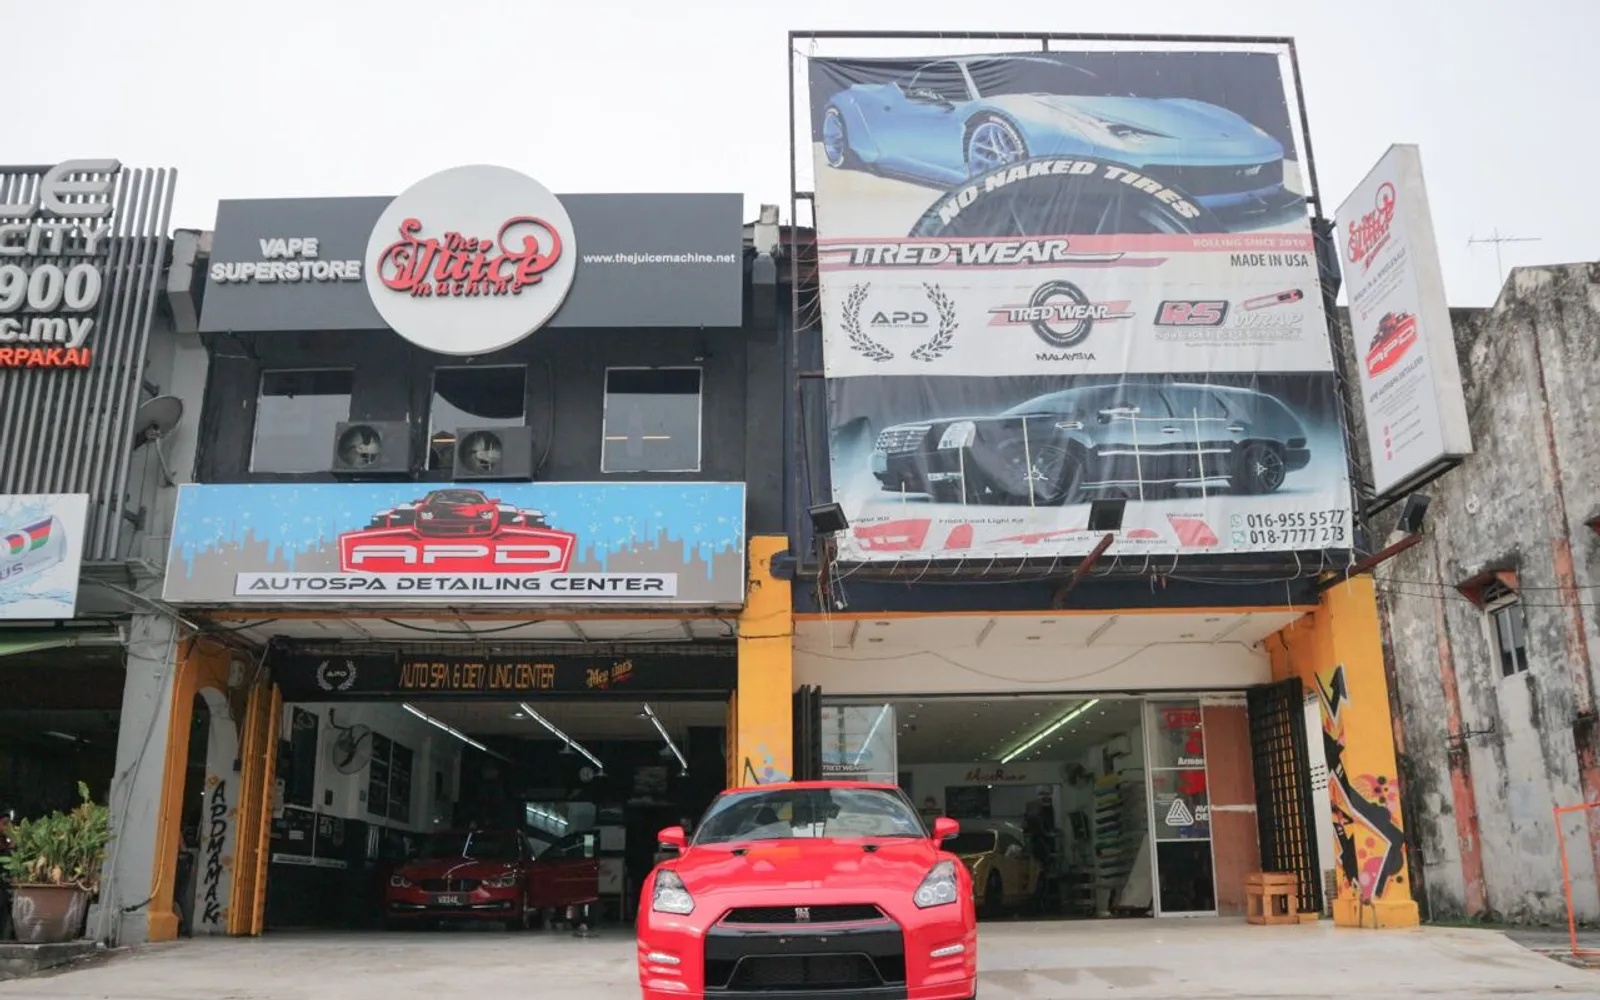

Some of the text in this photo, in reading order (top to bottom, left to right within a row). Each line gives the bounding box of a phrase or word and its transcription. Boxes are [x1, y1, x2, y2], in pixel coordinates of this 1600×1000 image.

[939, 160, 1201, 226] NO NAKED TIRES
[0, 222, 110, 256] CITY
[259, 237, 319, 259] VAPE
[444, 232, 479, 251] The
[377, 216, 562, 291] Juice
[583, 252, 736, 265] www.thejuicemachine.net
[1230, 253, 1309, 267] MADE IN USA
[210, 260, 362, 283] SUPERSTORE
[0, 263, 102, 313] 900
[411, 278, 523, 296] machine
[870, 311, 929, 324] APD
[1156, 300, 1228, 326] RS
[1233, 312, 1304, 328] WRAP
[0, 317, 94, 348] c.my
[1035, 352, 1096, 361] MALAYSIA
[1246, 510, 1345, 528] 016-955 5577
[1250, 526, 1345, 545] 018-7777 273
[350, 543, 562, 566] APD
[248, 576, 665, 591] AUTOSPA DETAILING CENTER
[398, 662, 429, 689] AUTO
[430, 662, 450, 689] SPA
[514, 662, 555, 689] CENTER
